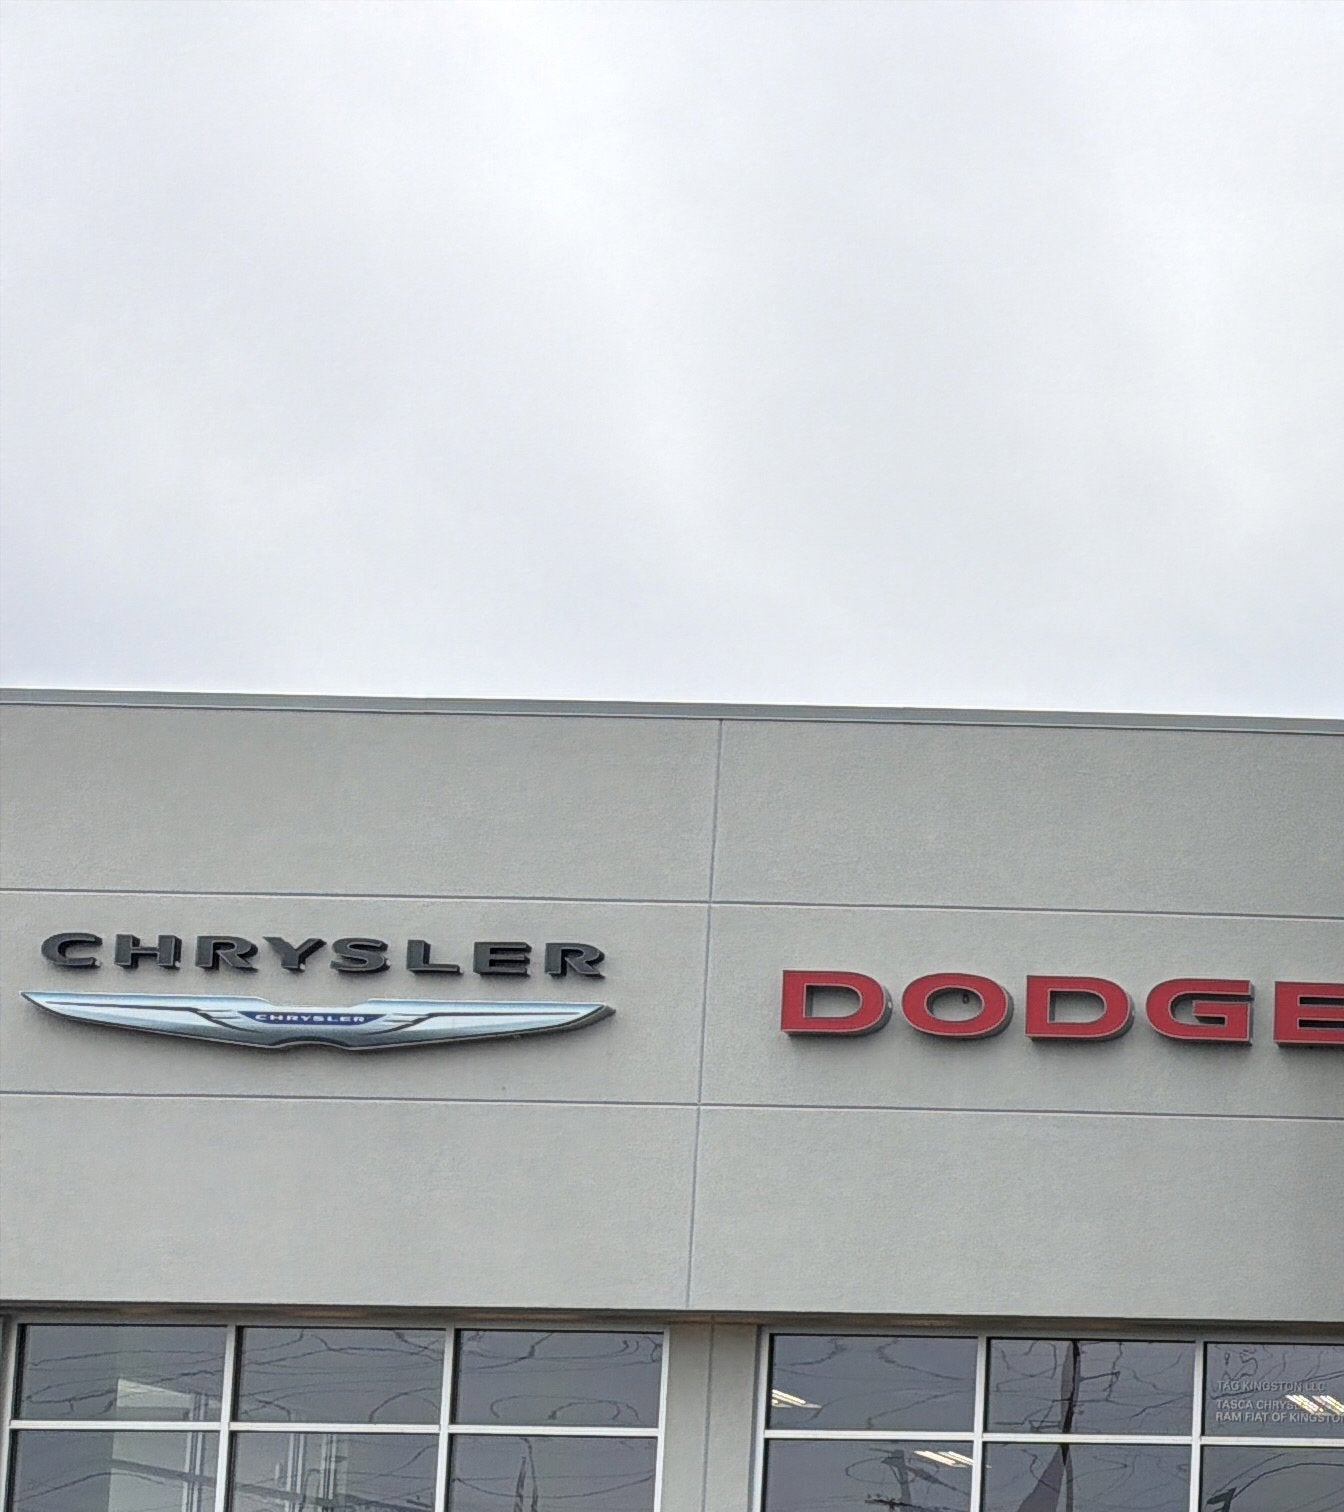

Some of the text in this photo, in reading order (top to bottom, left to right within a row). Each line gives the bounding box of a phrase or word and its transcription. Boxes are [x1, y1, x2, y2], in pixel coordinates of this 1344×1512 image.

[41, 932, 606, 979] CHRYSLER
[255, 1014, 365, 1022] CHRYSLER
[1217, 1381, 1239, 1391] TAG
[1242, 1381, 1303, 1392] KINGSTON
[1216, 1400, 1253, 1409] TASCA
[1216, 1411, 1241, 1422] RAM
[1245, 1411, 1268, 1422] FIAT
[1271, 1412, 1287, 1421] OF
